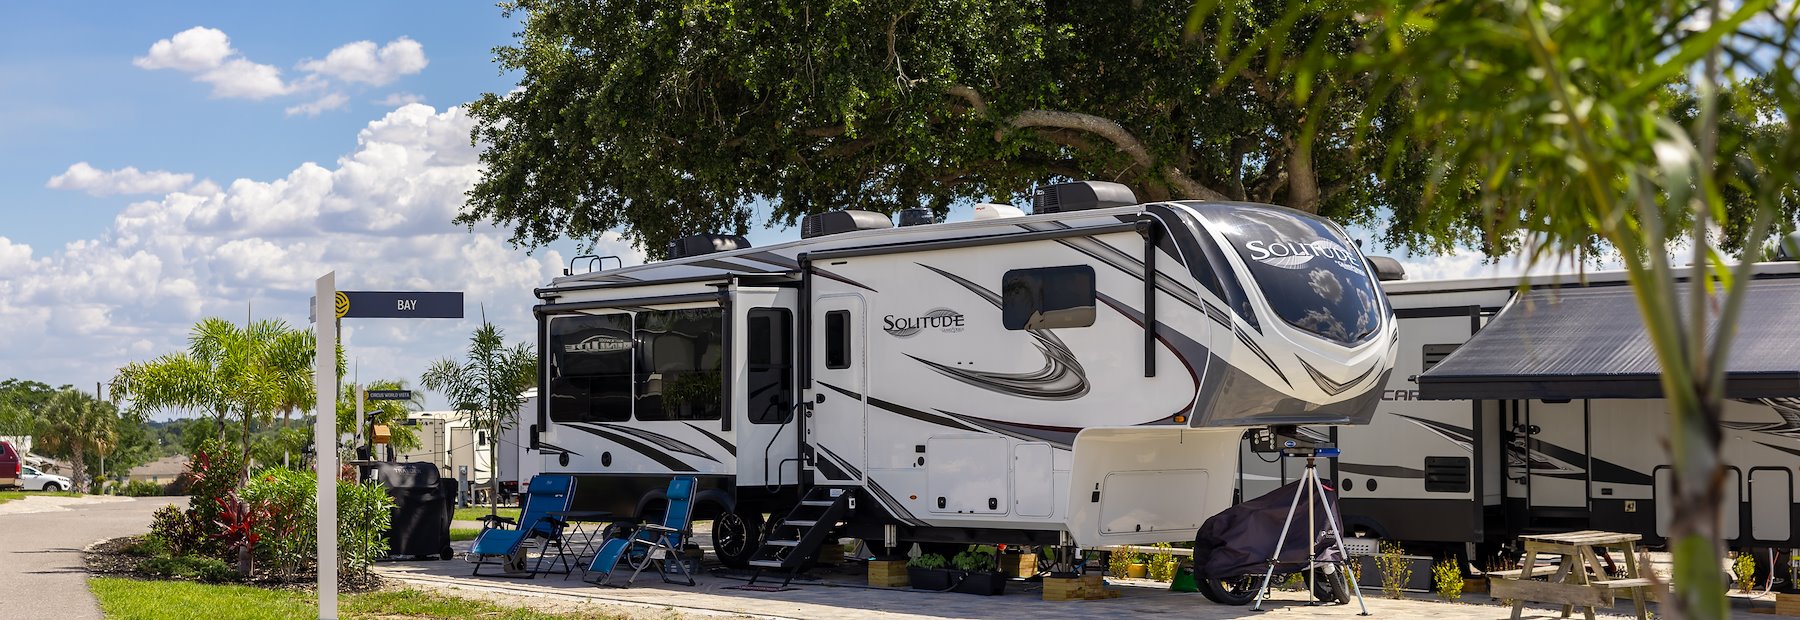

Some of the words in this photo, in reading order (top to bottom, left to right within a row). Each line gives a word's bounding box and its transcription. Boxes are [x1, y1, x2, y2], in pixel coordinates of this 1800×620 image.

[1245, 240, 1360, 267] SOLITUDE
[397, 299, 417, 310] BAY
[883, 314, 965, 330] SOLITUDE
